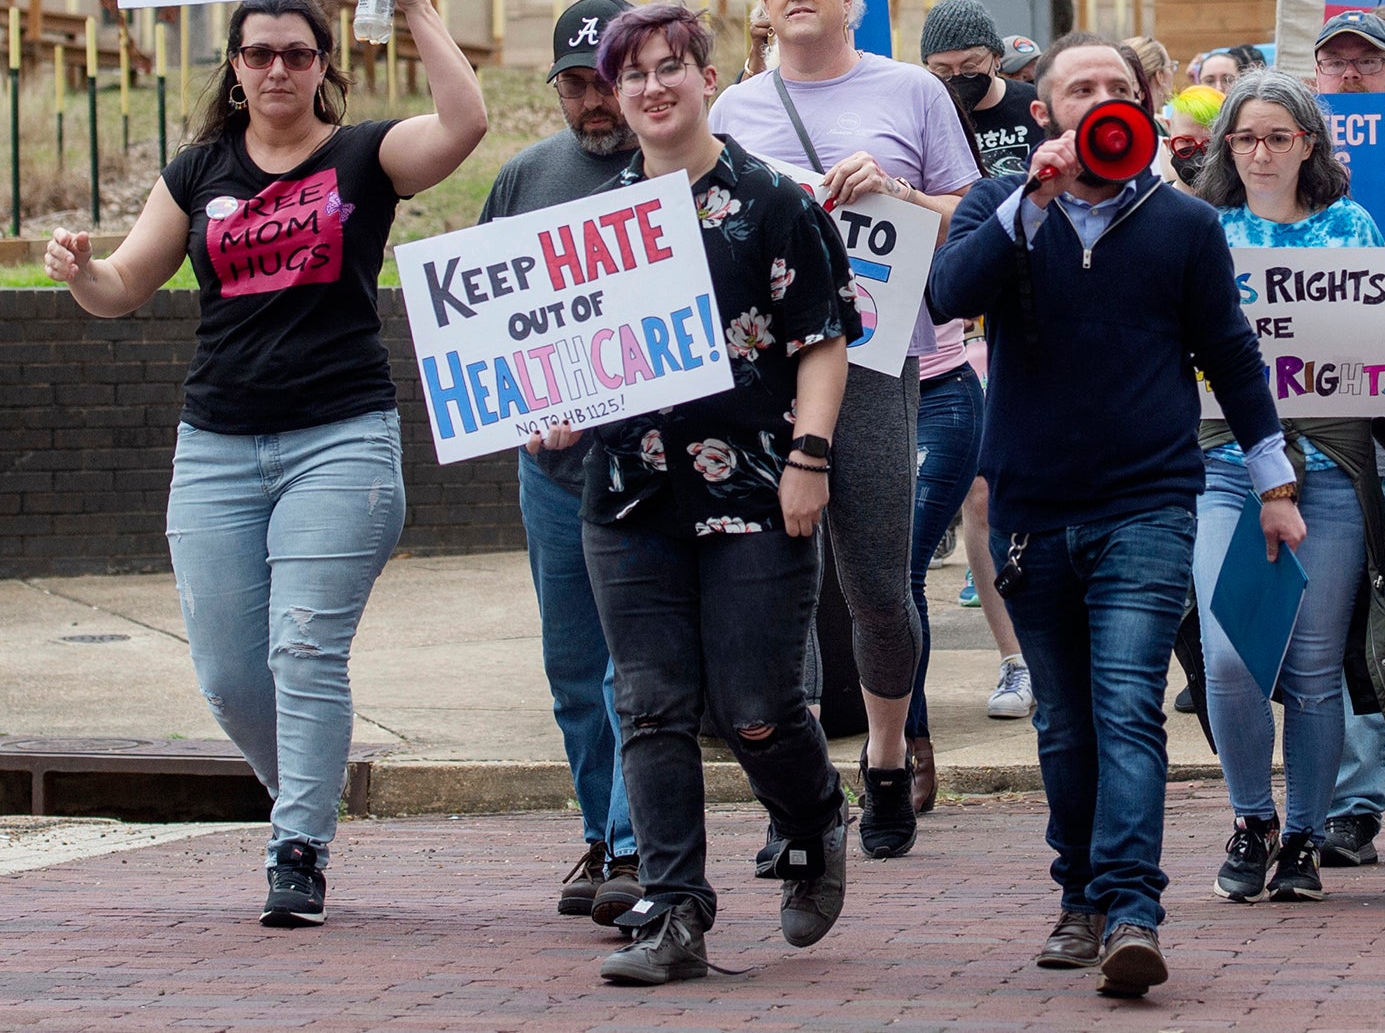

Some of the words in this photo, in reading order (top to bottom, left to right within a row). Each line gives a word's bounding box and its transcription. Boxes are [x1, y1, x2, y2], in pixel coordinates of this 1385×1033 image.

[568, 17, 599, 47] A
[243, 183, 324, 219] REE
[220, 210, 319, 253] MOM
[840, 210, 897, 256] TO
[230, 243, 331, 281] HUGS
[423, 256, 536, 328] KEEP
[537, 198, 673, 291] HATE
[508, 301, 564, 341] OUT
[571, 290, 604, 323] OF
[422, 293, 721, 440] HEALTHCARE!
